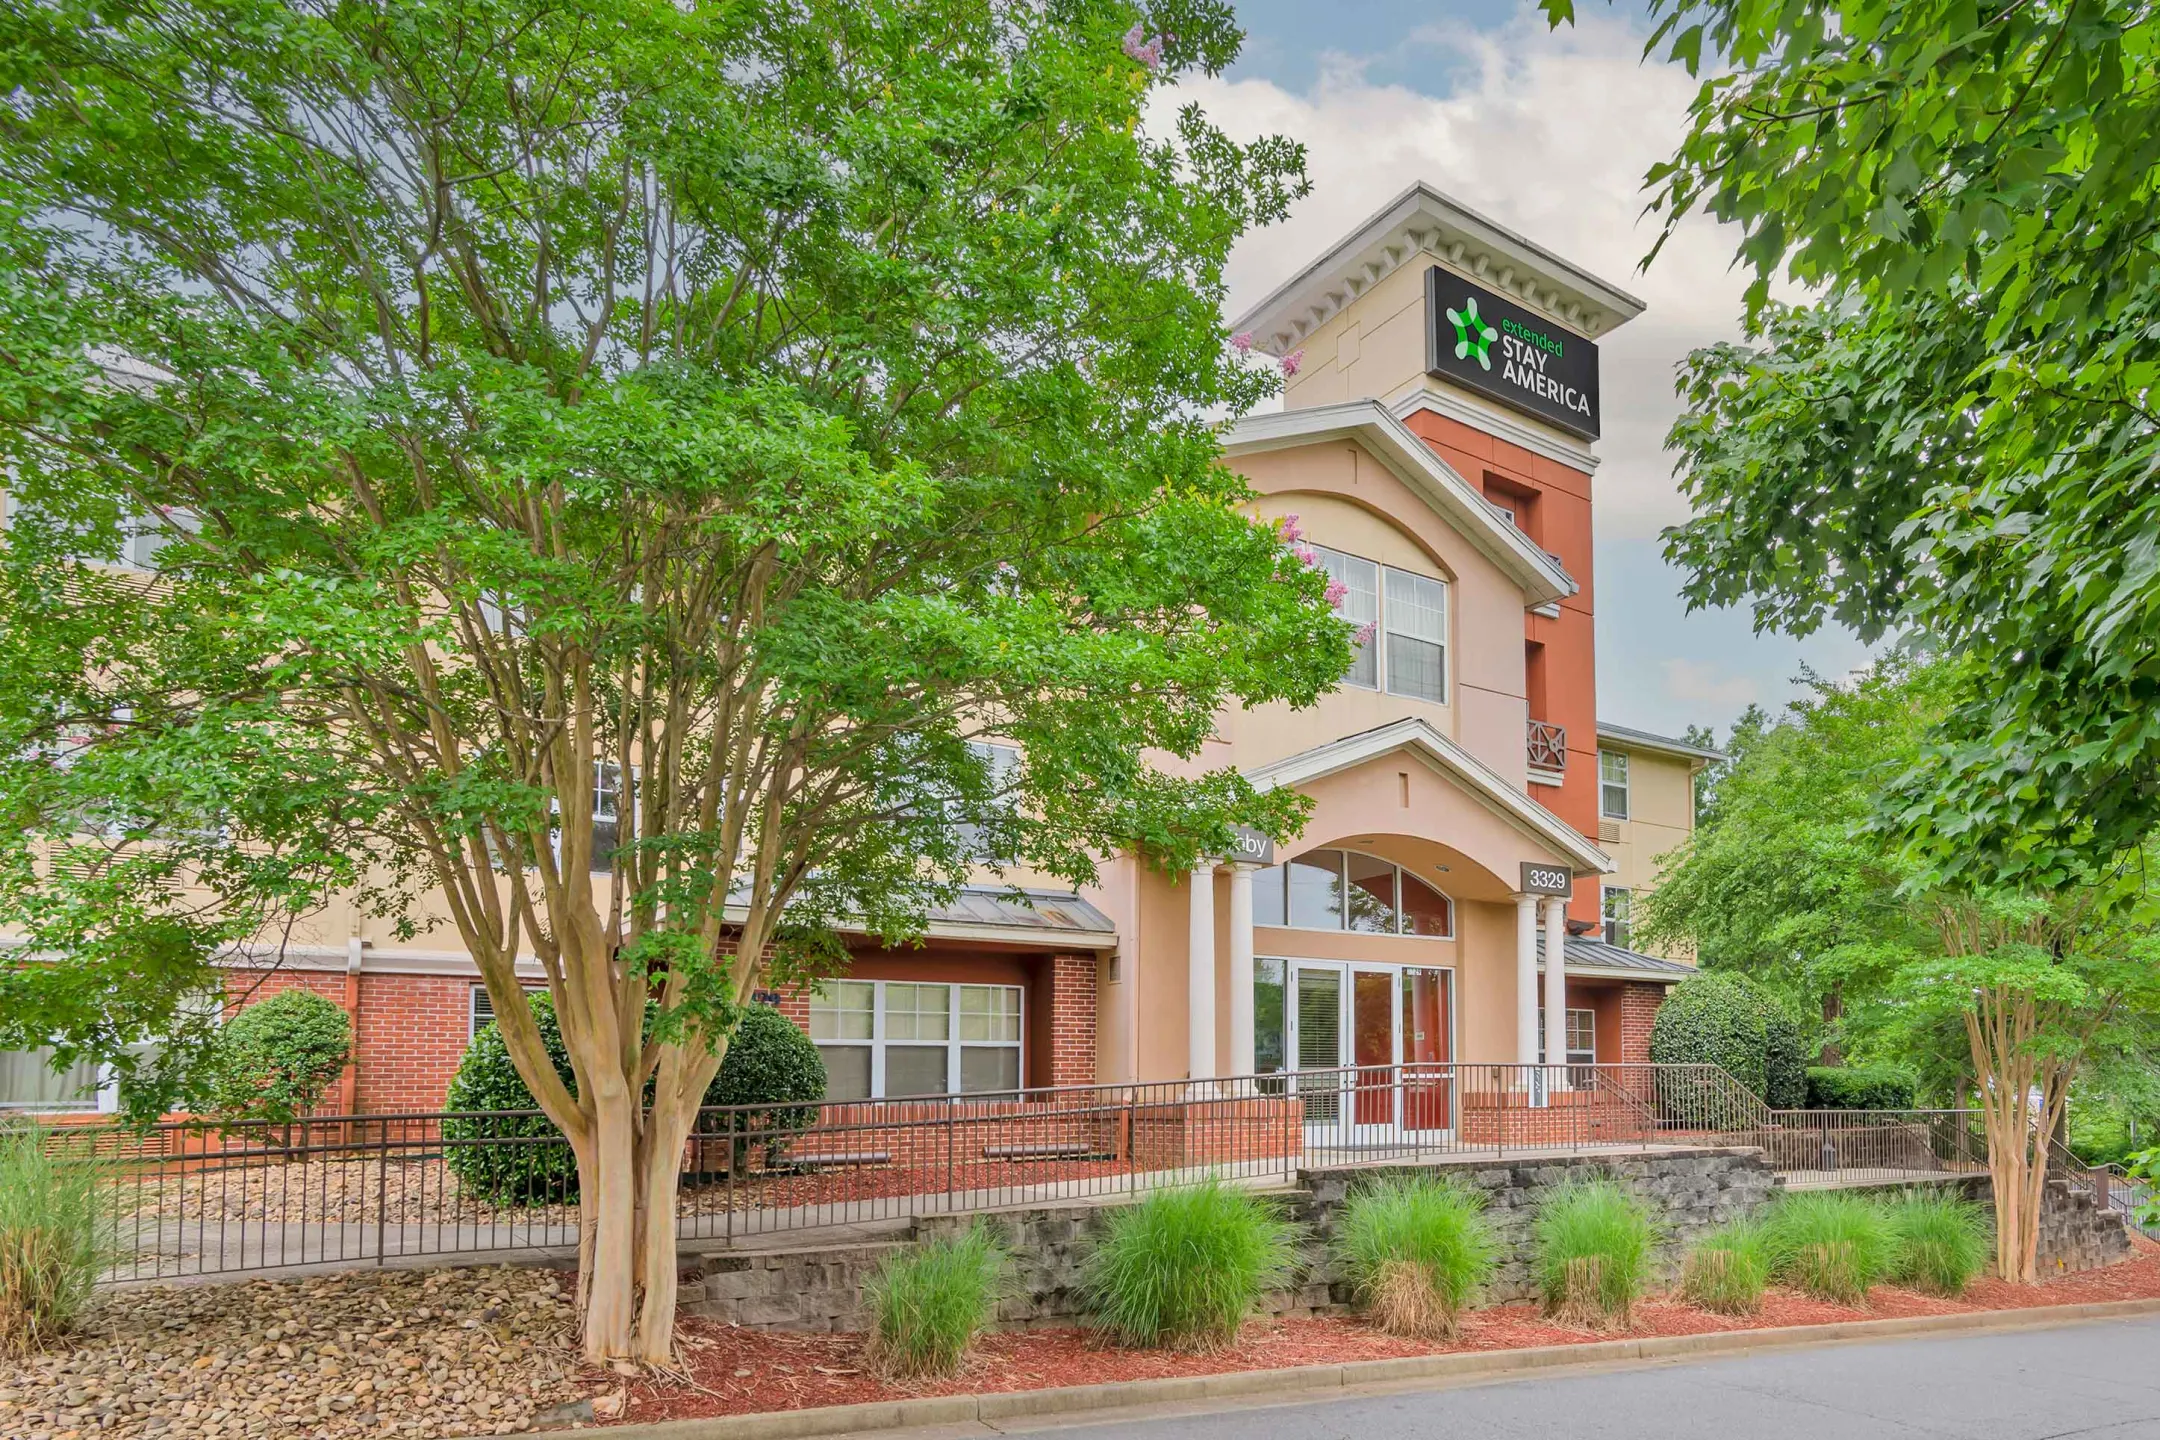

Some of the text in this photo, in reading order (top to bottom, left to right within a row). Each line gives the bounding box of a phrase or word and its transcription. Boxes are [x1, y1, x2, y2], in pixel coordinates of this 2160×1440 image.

[1502, 318, 1563, 358] extended
[1503, 335, 1548, 373] STAY
[1502, 360, 1591, 416] AMERICA
[1530, 869, 1566, 889] 3329
